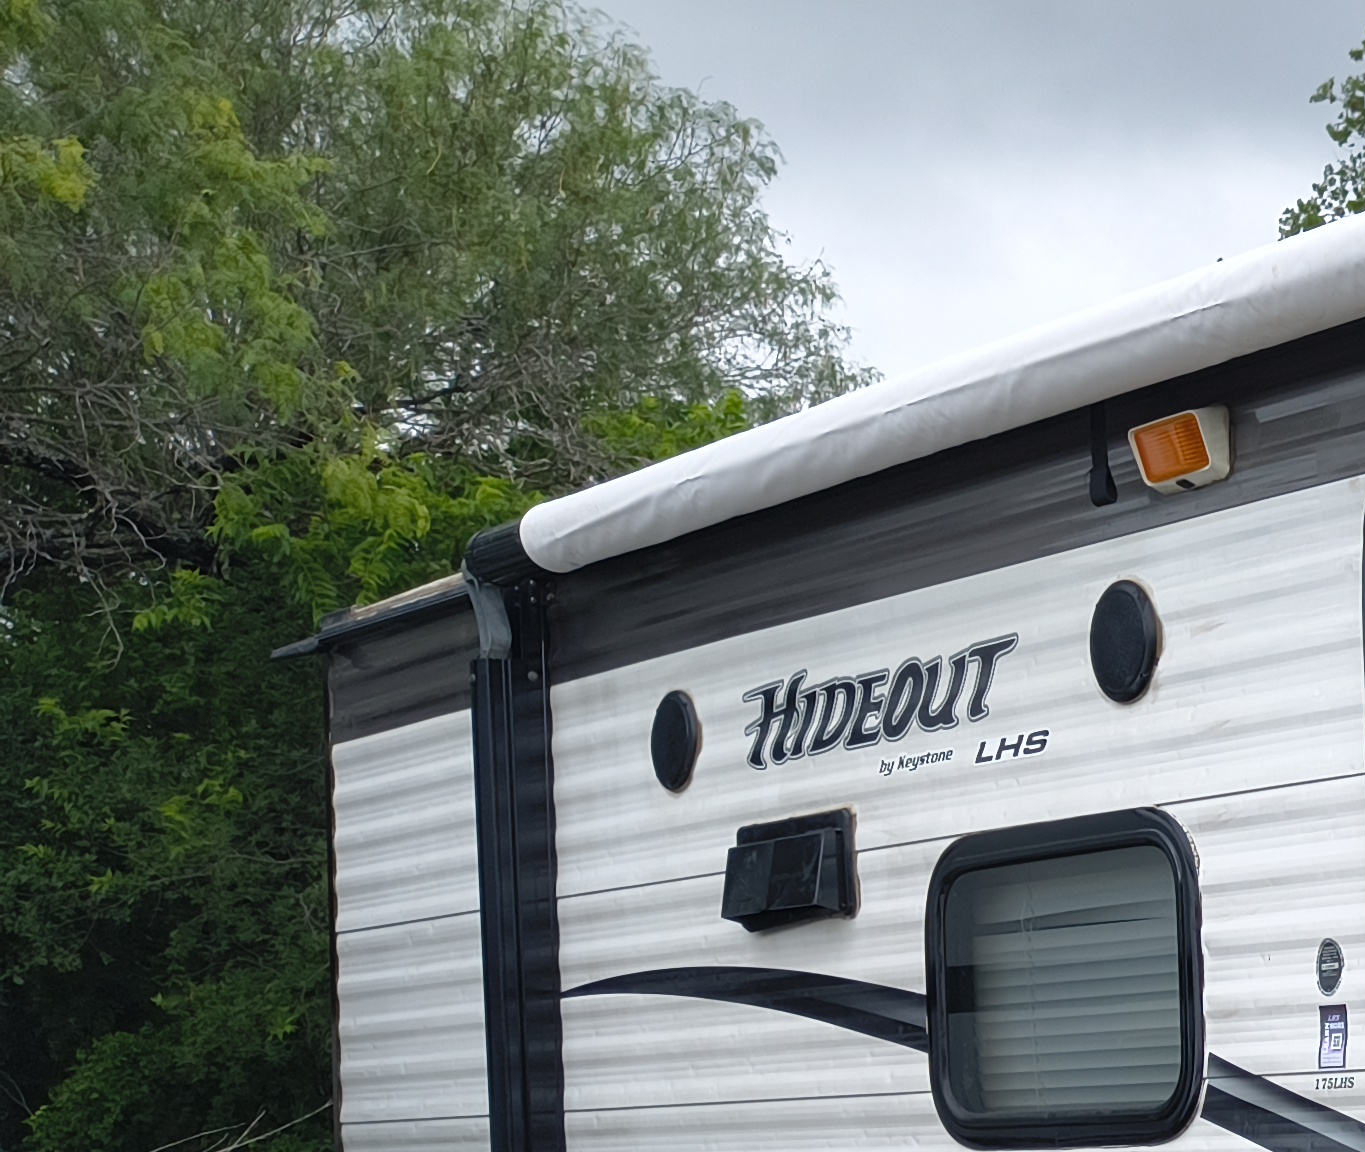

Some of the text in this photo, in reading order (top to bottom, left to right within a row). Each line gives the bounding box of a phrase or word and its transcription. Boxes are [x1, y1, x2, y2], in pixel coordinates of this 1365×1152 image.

[742, 632, 1019, 770] HIDEOUT
[879, 729, 1050, 776] by Keystone LHS
[1315, 1076, 1355, 1090] 175LHS
